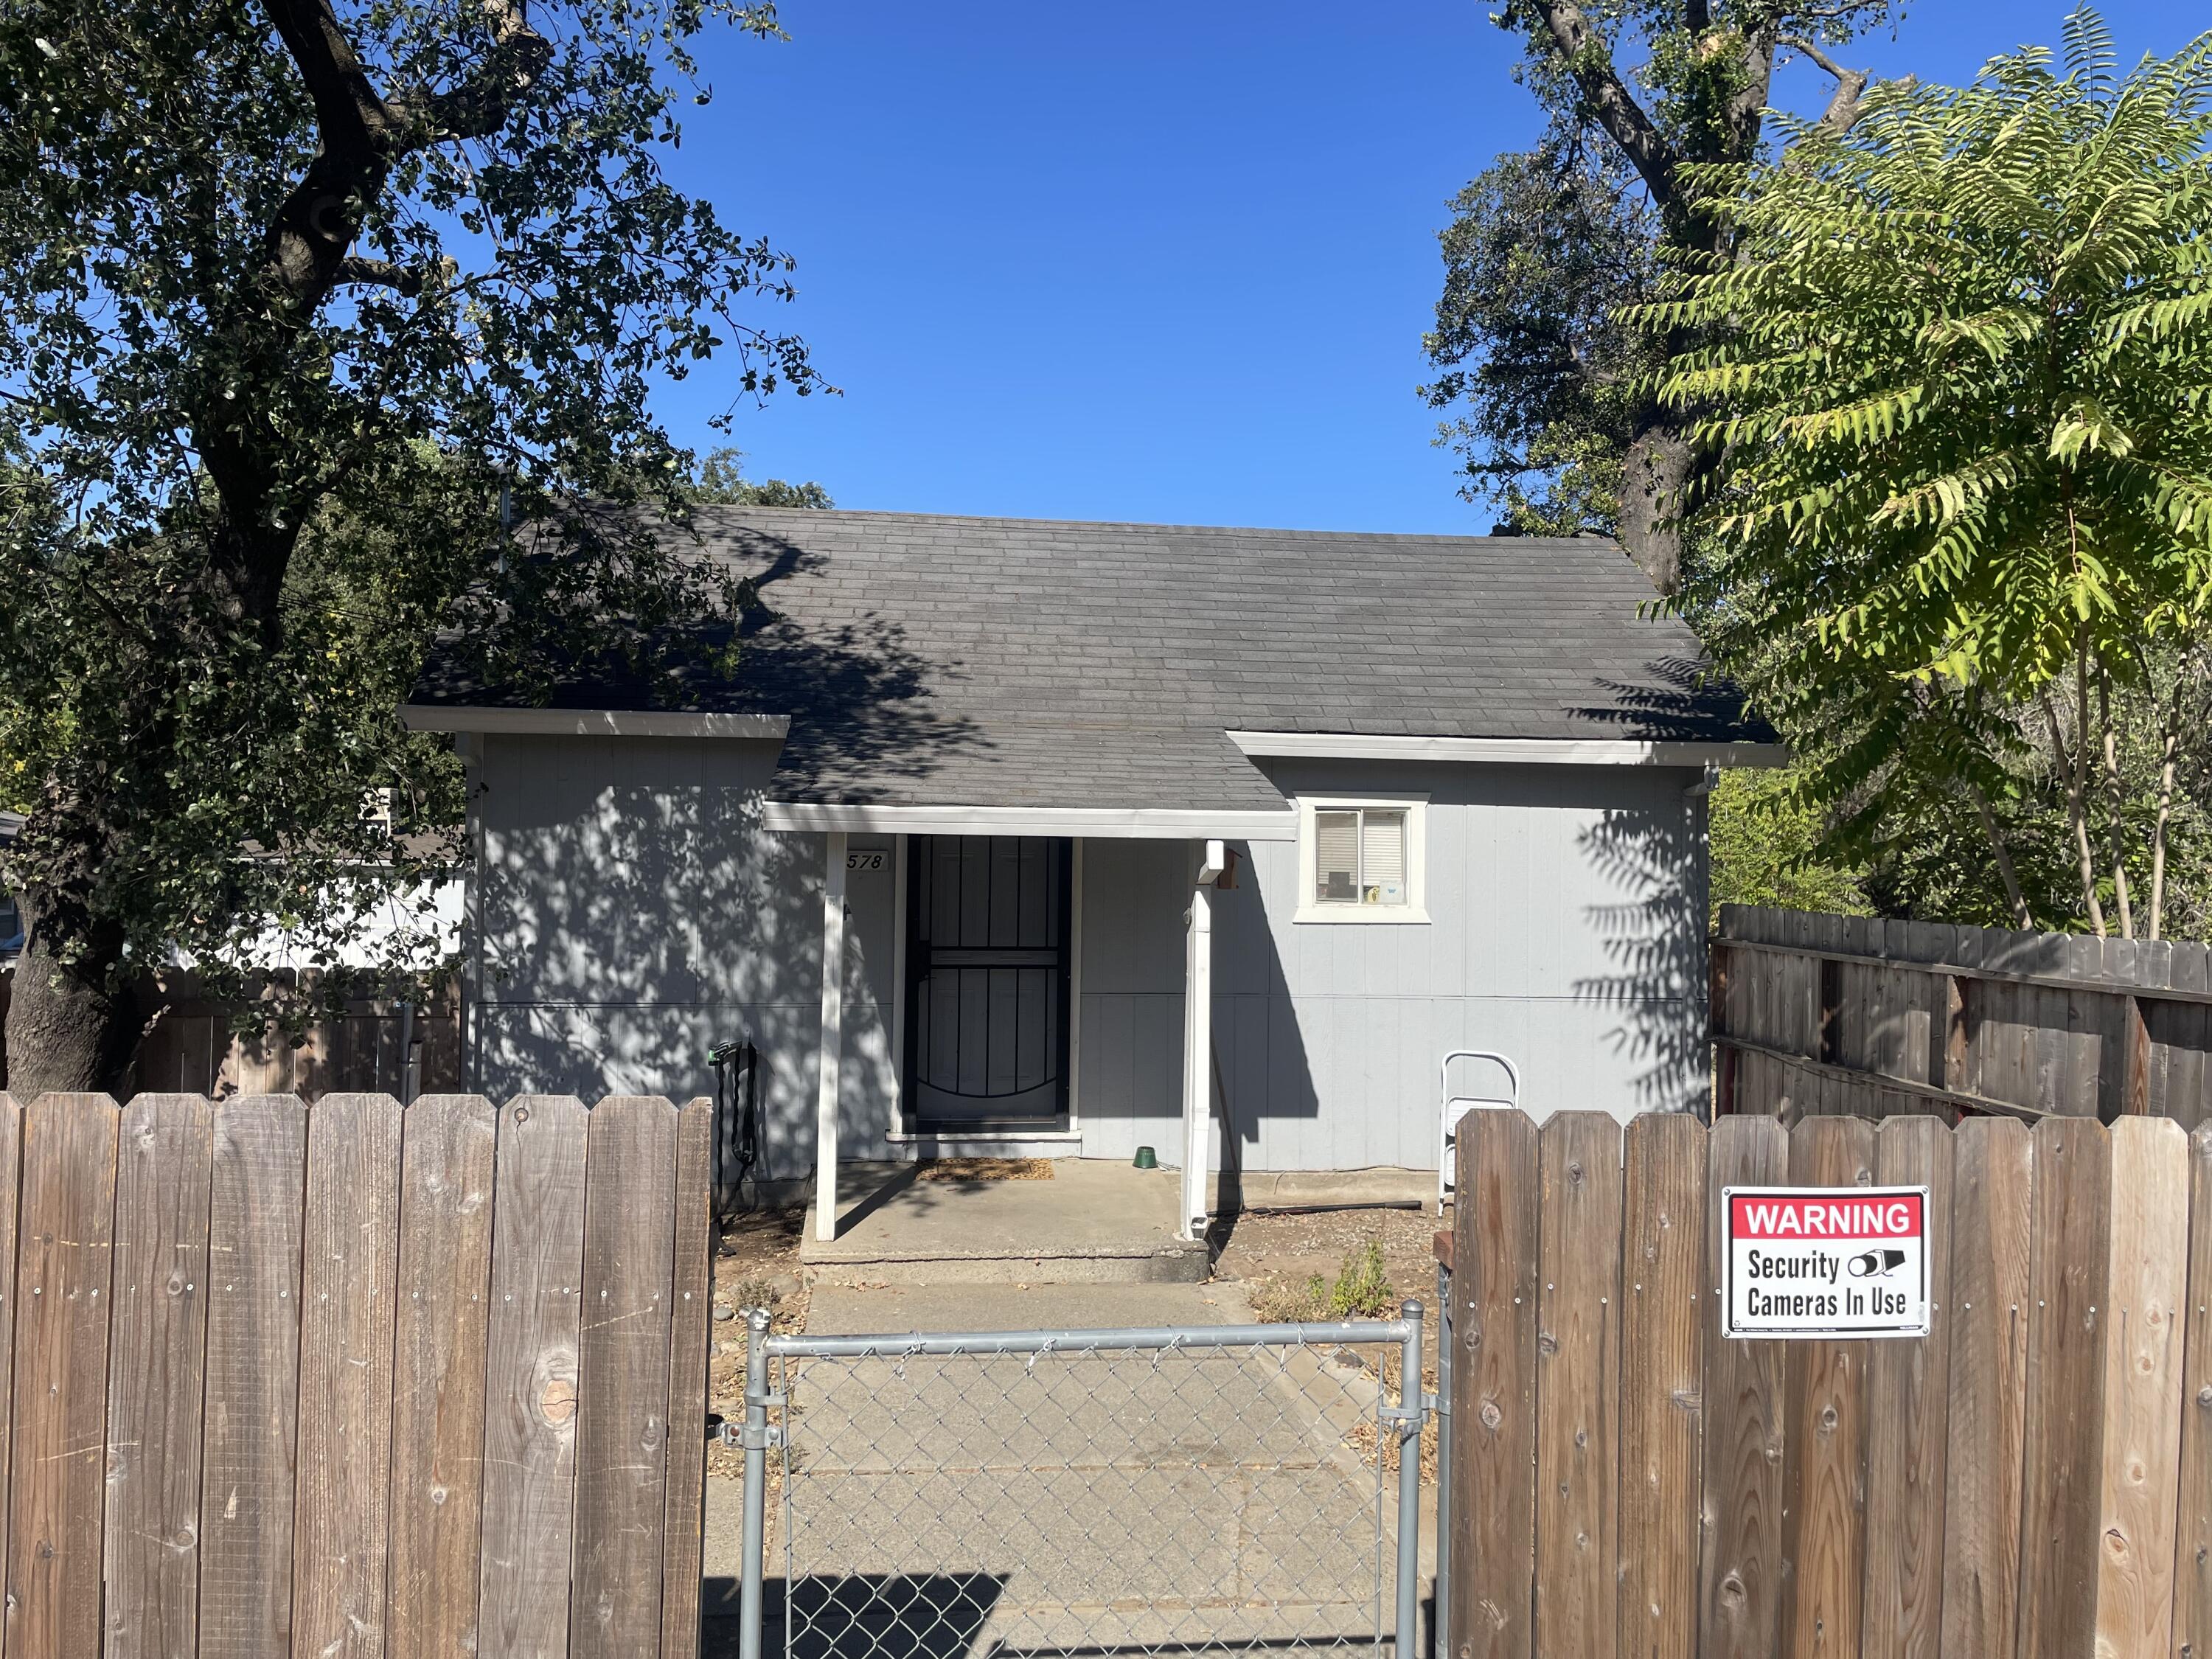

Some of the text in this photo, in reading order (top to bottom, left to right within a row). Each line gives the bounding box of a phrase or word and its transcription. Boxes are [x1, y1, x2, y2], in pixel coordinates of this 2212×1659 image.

[846, 855, 882, 869] 578
[1745, 1203, 1910, 1235] WARNING
[1748, 1249, 1840, 1284] Security
[1748, 1287, 1906, 1316] Cameras In Use
